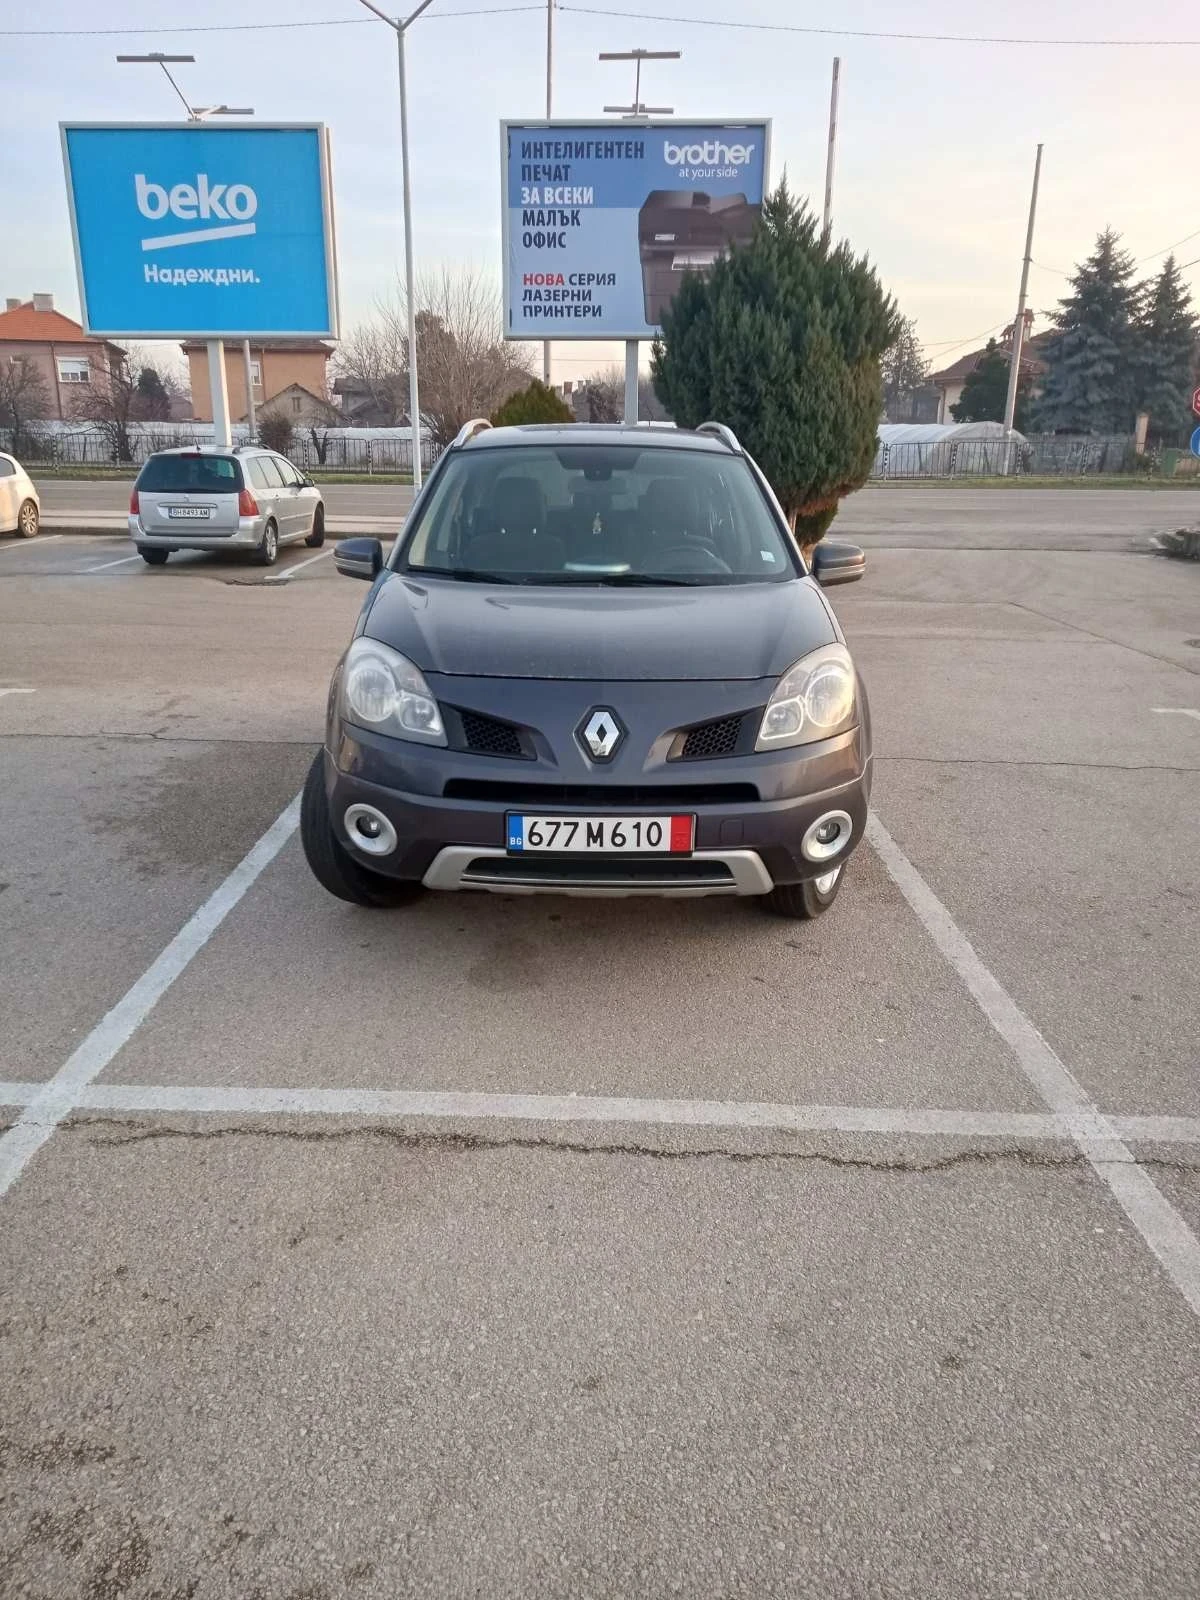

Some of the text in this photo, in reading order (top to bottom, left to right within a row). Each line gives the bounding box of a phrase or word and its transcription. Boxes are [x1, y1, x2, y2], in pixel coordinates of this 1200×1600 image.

[521, 141, 645, 159] ИНТЕЛИГЕНТЕН
[664, 140, 755, 165] brother
[521, 164, 571, 182] ПЕЧАТ
[679, 166, 738, 181] at your side
[134, 173, 258, 220] beko
[521, 186, 594, 205] ЗА ВСЕКИ
[522, 209, 581, 227] МАЛЪК
[522, 231, 567, 249] ОФИС
[143, 263, 261, 286] Надеждни.
[523, 272, 617, 286] НОВА СЕРИЯ
[522, 289, 592, 302] ЛАЗЕРНИ
[523, 304, 602, 318] ПРИНТЕРИ
[510, 837, 522, 846] BG
[528, 821, 579, 848] 677
[586, 821, 604, 848] M
[610, 821, 663, 848] 610
